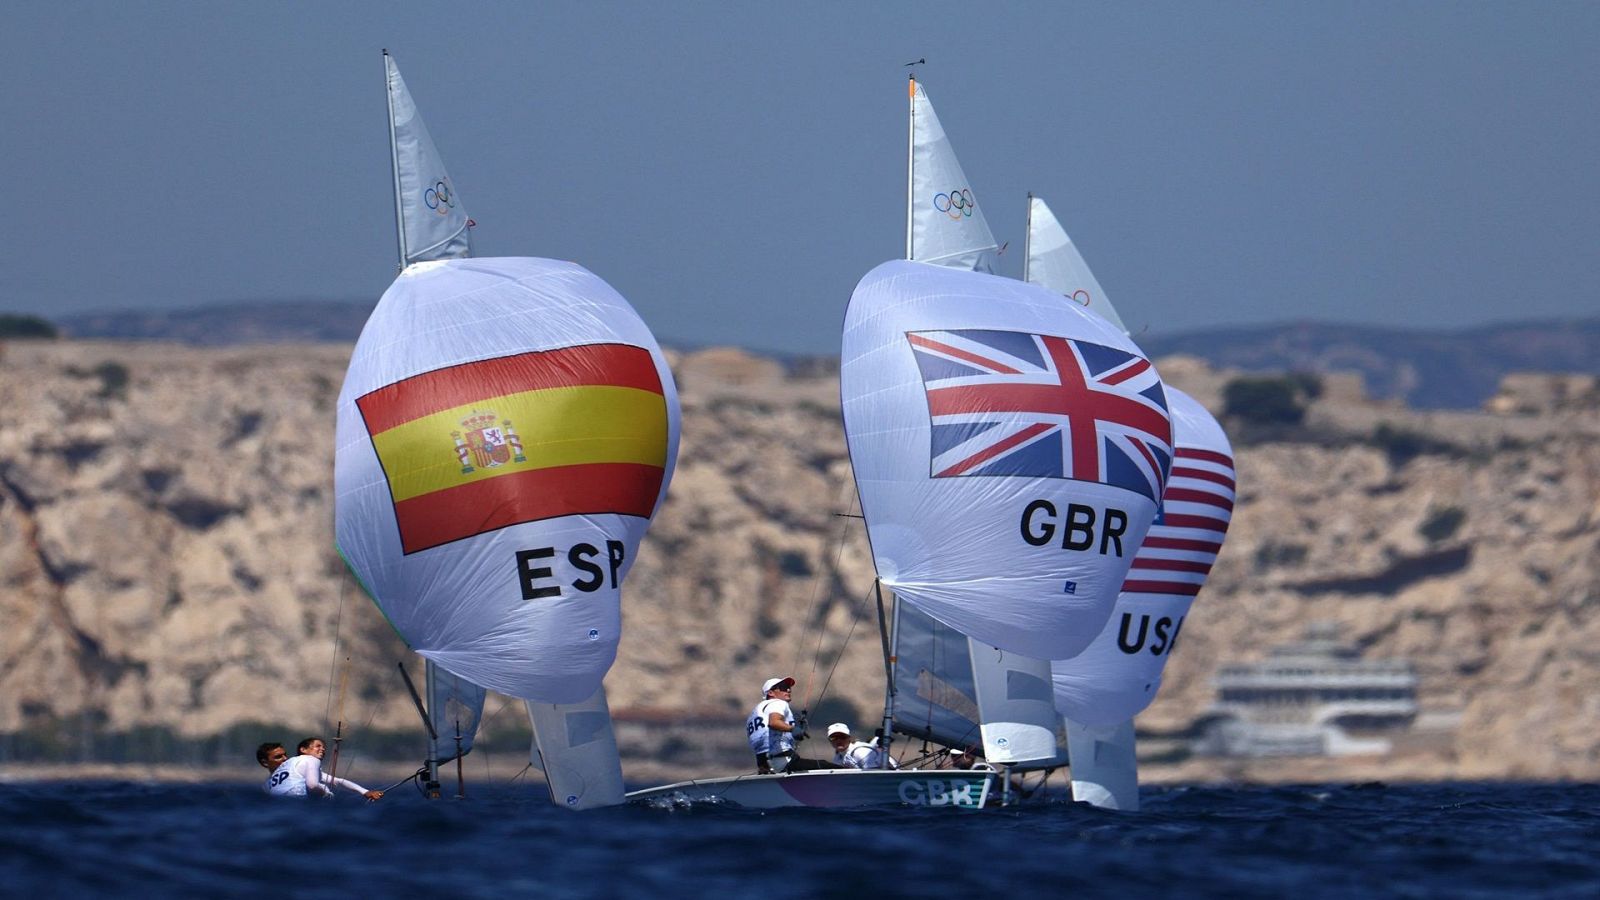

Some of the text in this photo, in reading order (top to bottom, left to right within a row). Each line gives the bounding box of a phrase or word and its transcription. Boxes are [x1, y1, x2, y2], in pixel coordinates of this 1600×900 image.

[1020, 499, 1128, 558] GBR
[515, 539, 625, 601] ESP
[746, 716, 766, 736] BR
[270, 771, 290, 788] SP
[898, 779, 973, 806] GBR
